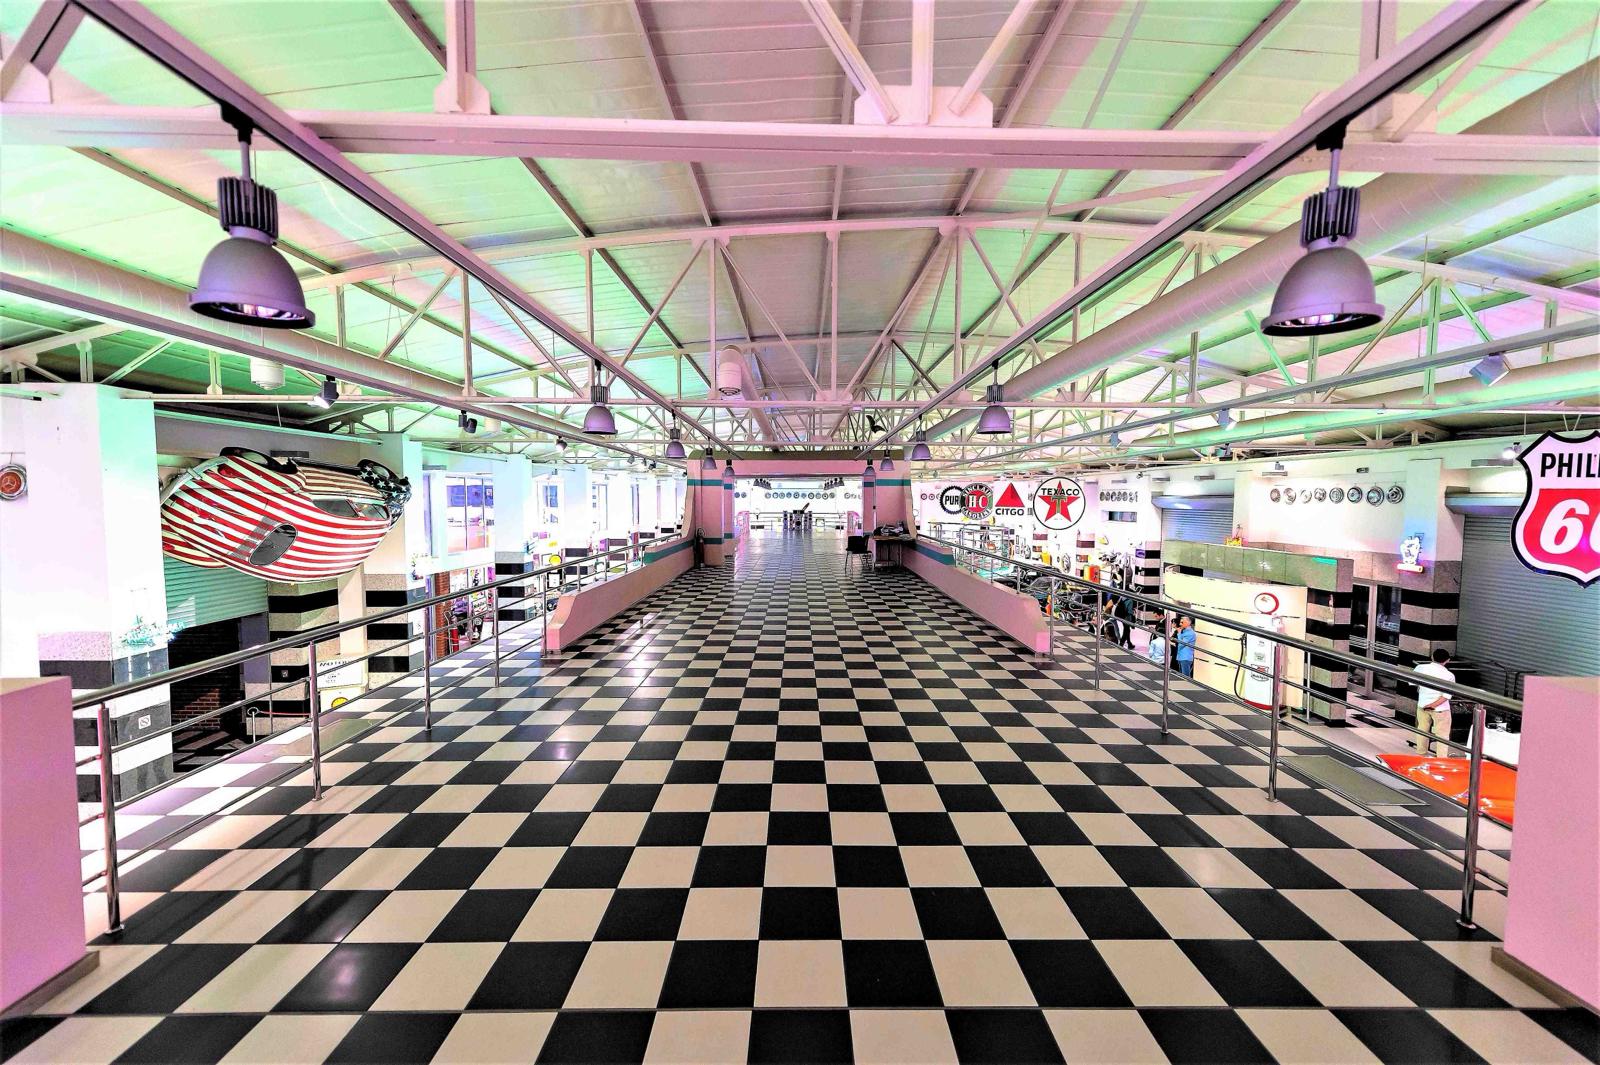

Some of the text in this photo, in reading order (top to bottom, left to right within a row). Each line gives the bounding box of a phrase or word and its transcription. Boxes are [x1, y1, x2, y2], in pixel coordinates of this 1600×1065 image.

[1541, 453, 1600, 478] PHIL
[1041, 488, 1080, 496] TEXACO
[995, 508, 1025, 516] CITGO
[1539, 498, 1600, 555] 6
